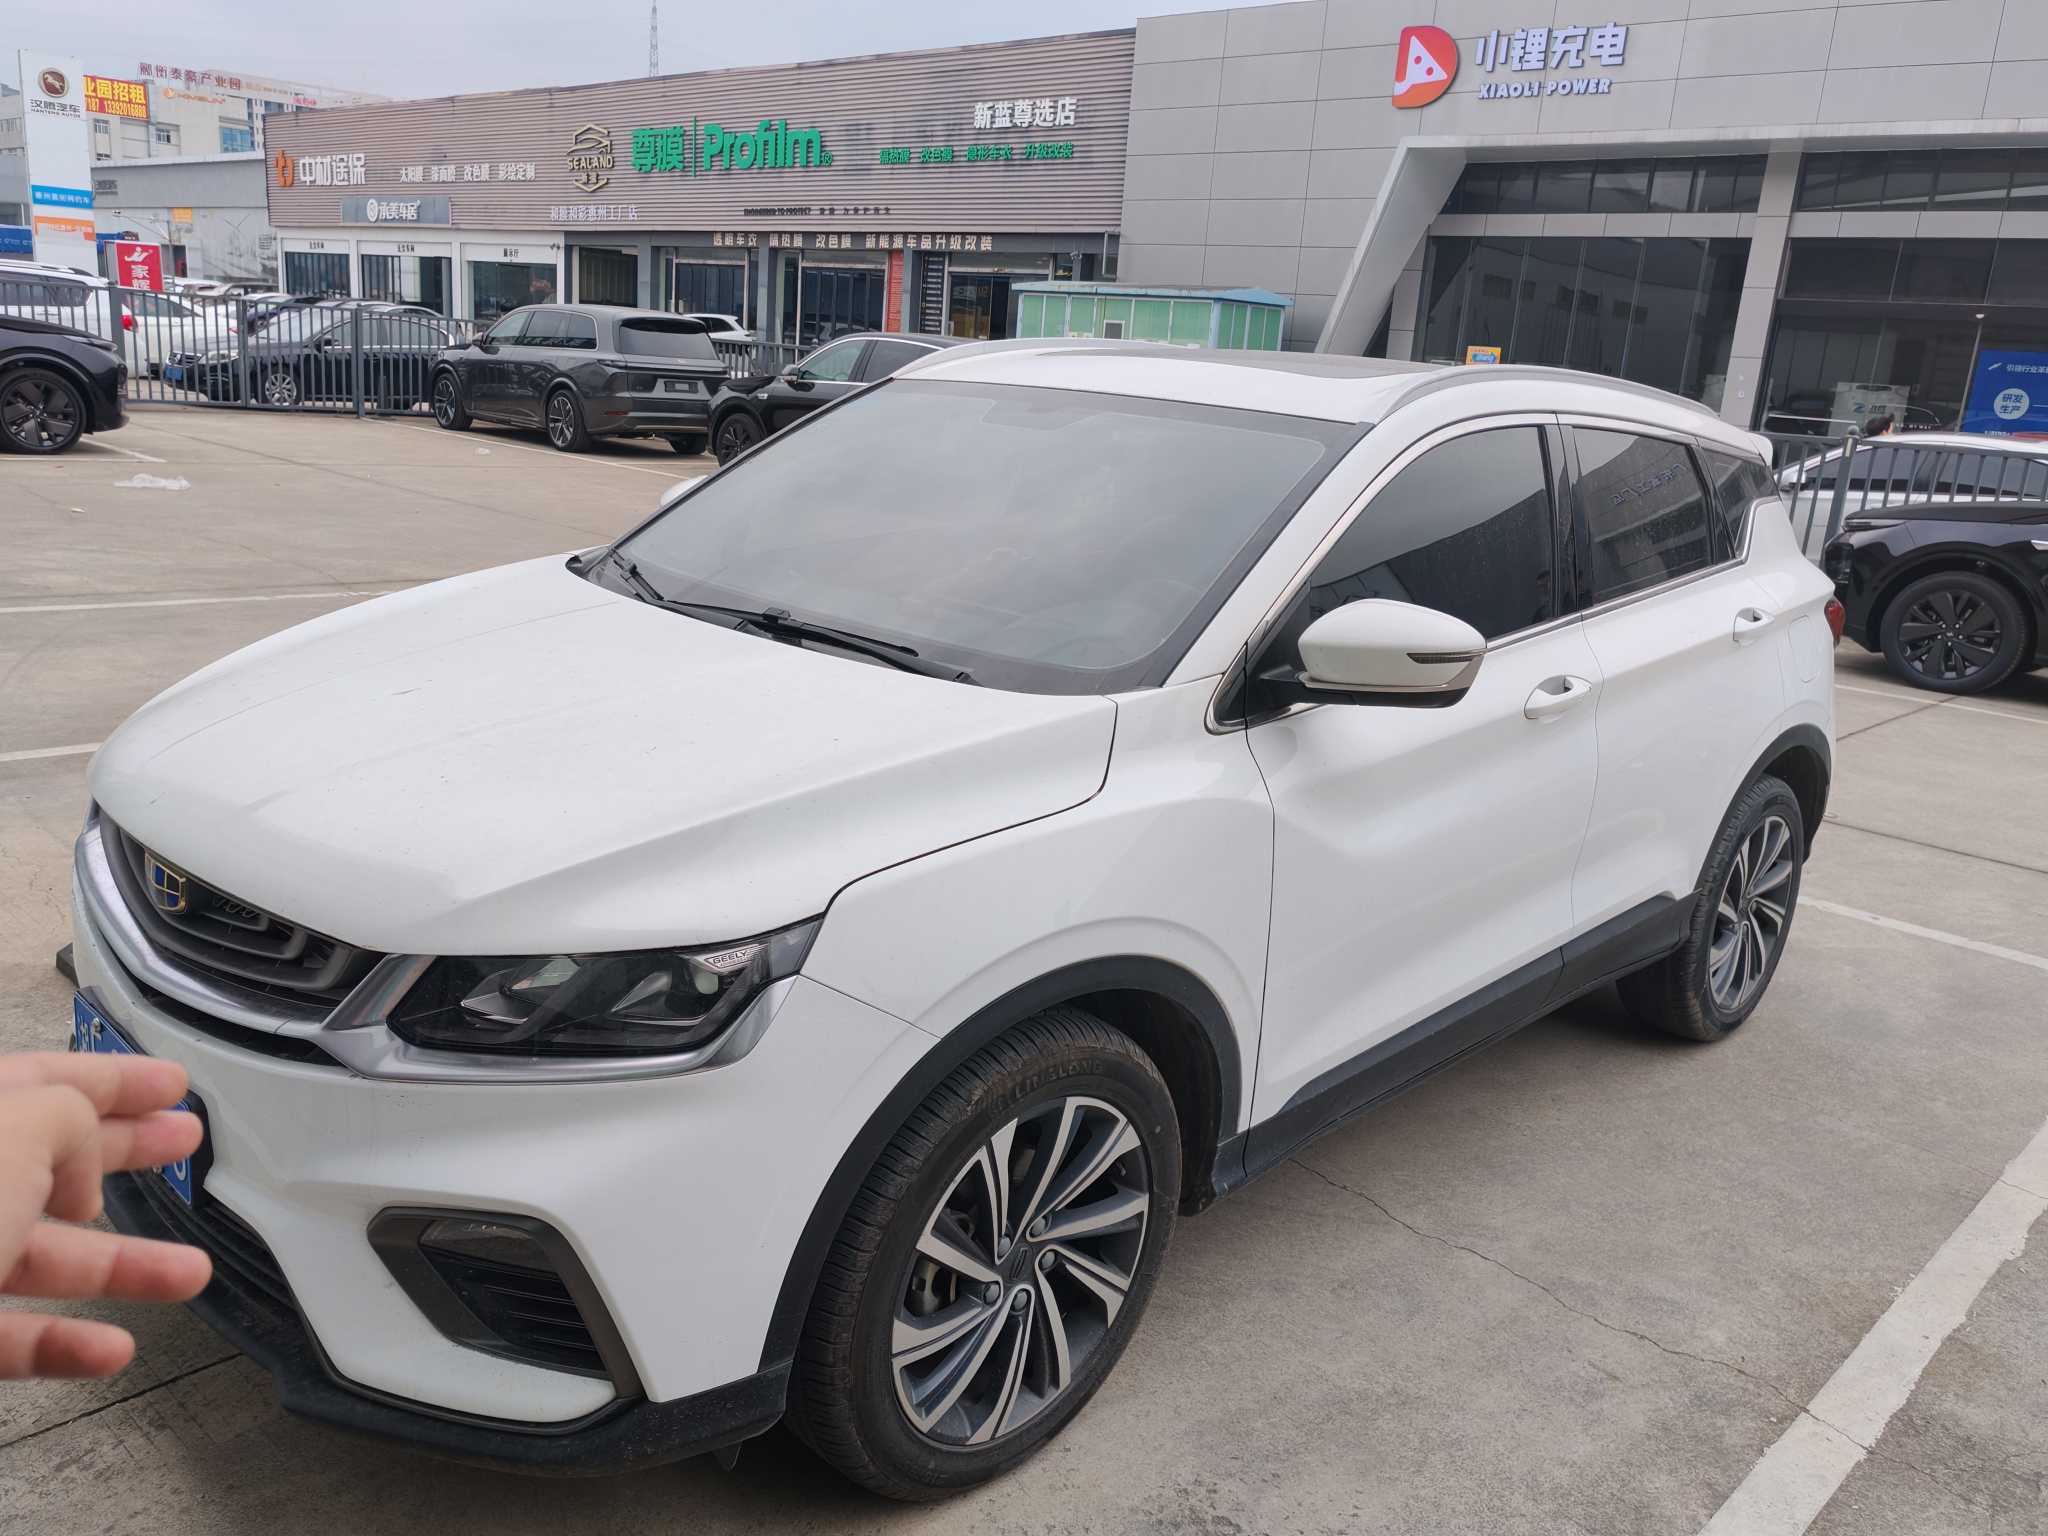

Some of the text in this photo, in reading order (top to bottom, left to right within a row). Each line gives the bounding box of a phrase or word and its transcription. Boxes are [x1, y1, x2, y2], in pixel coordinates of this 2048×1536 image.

[1475, 21, 1629, 72] 小锂充电
[1477, 78, 1612, 99] XIAOLI POWER
[974, 96, 1078, 129] 新蓝尊选店
[632, 125, 685, 173] 尊膜
[703, 119, 823, 171] Profilm
[921, 145, 953, 164] 改色膜
[966, 143, 1013, 161] 隐形车衣
[1024, 140, 1074, 161] 升级改装
[567, 154, 614, 171] SEALAND
[713, 232, 993, 251] 透明车衣 隔热膜 改色膜 新能源车品升级改装
[2002, 393, 2024, 403] 研发
[1999, 405, 2022, 415] 生产
[712, 950, 748, 964] GEELY
